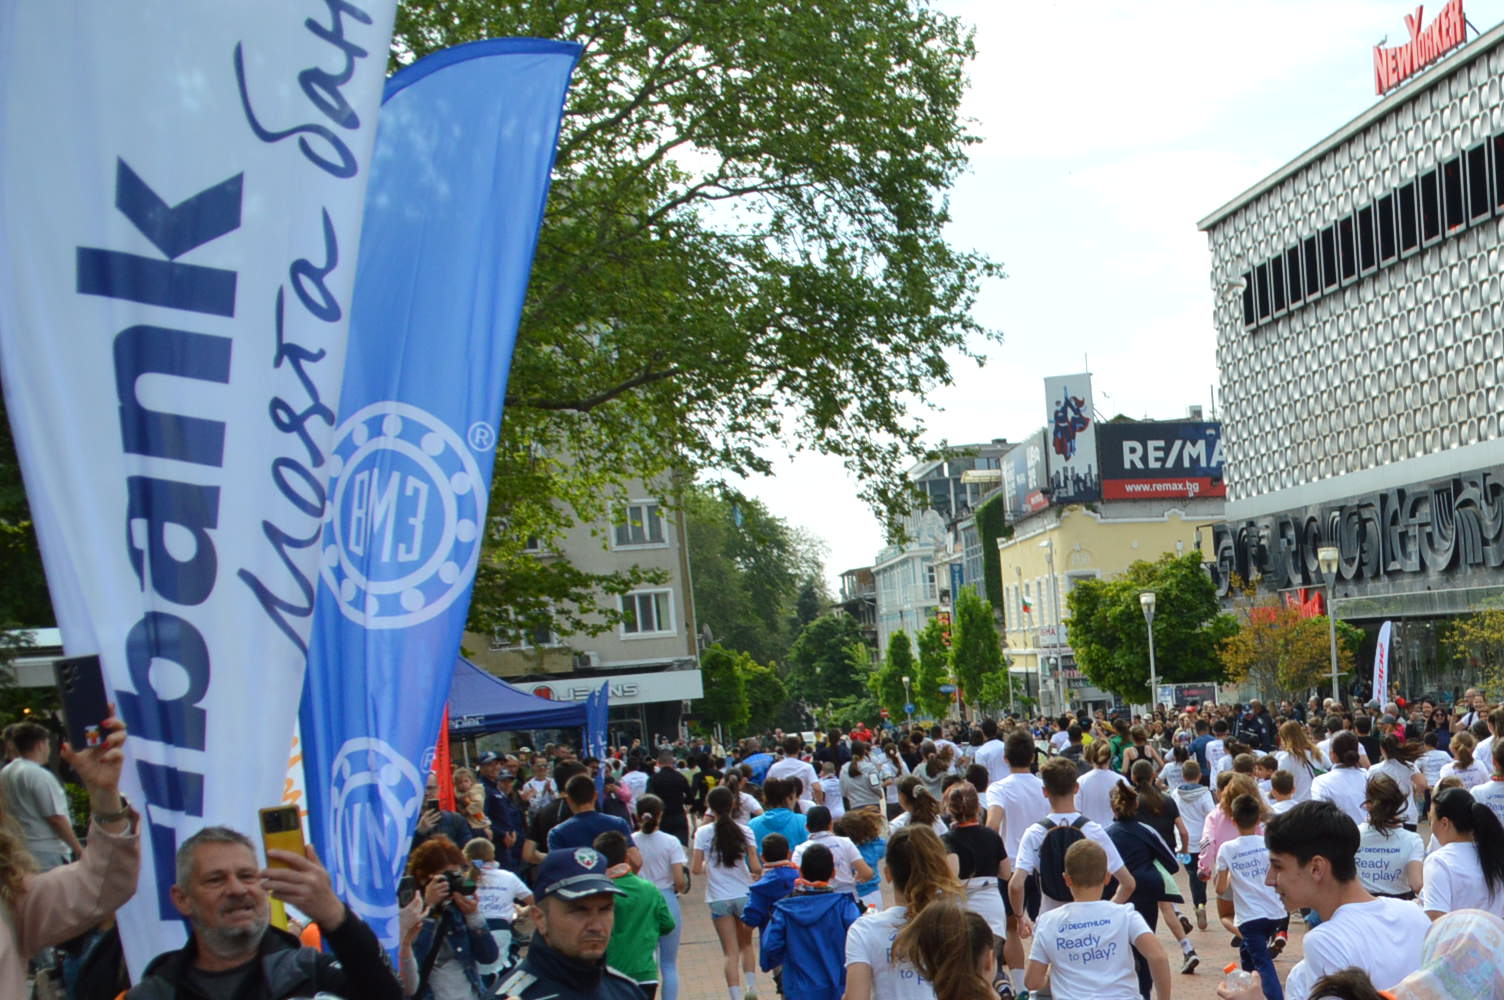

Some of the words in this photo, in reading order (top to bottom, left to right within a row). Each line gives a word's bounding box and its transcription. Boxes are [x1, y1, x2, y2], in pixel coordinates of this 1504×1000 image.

[1122, 440, 1226, 470] RE/MA
[1125, 480, 1200, 493] www.remax.bg
[556, 684, 639, 701] JENS
[1056, 933, 1101, 951] Ready
[1068, 953, 1080, 962] to
[1082, 942, 1117, 965] play?
